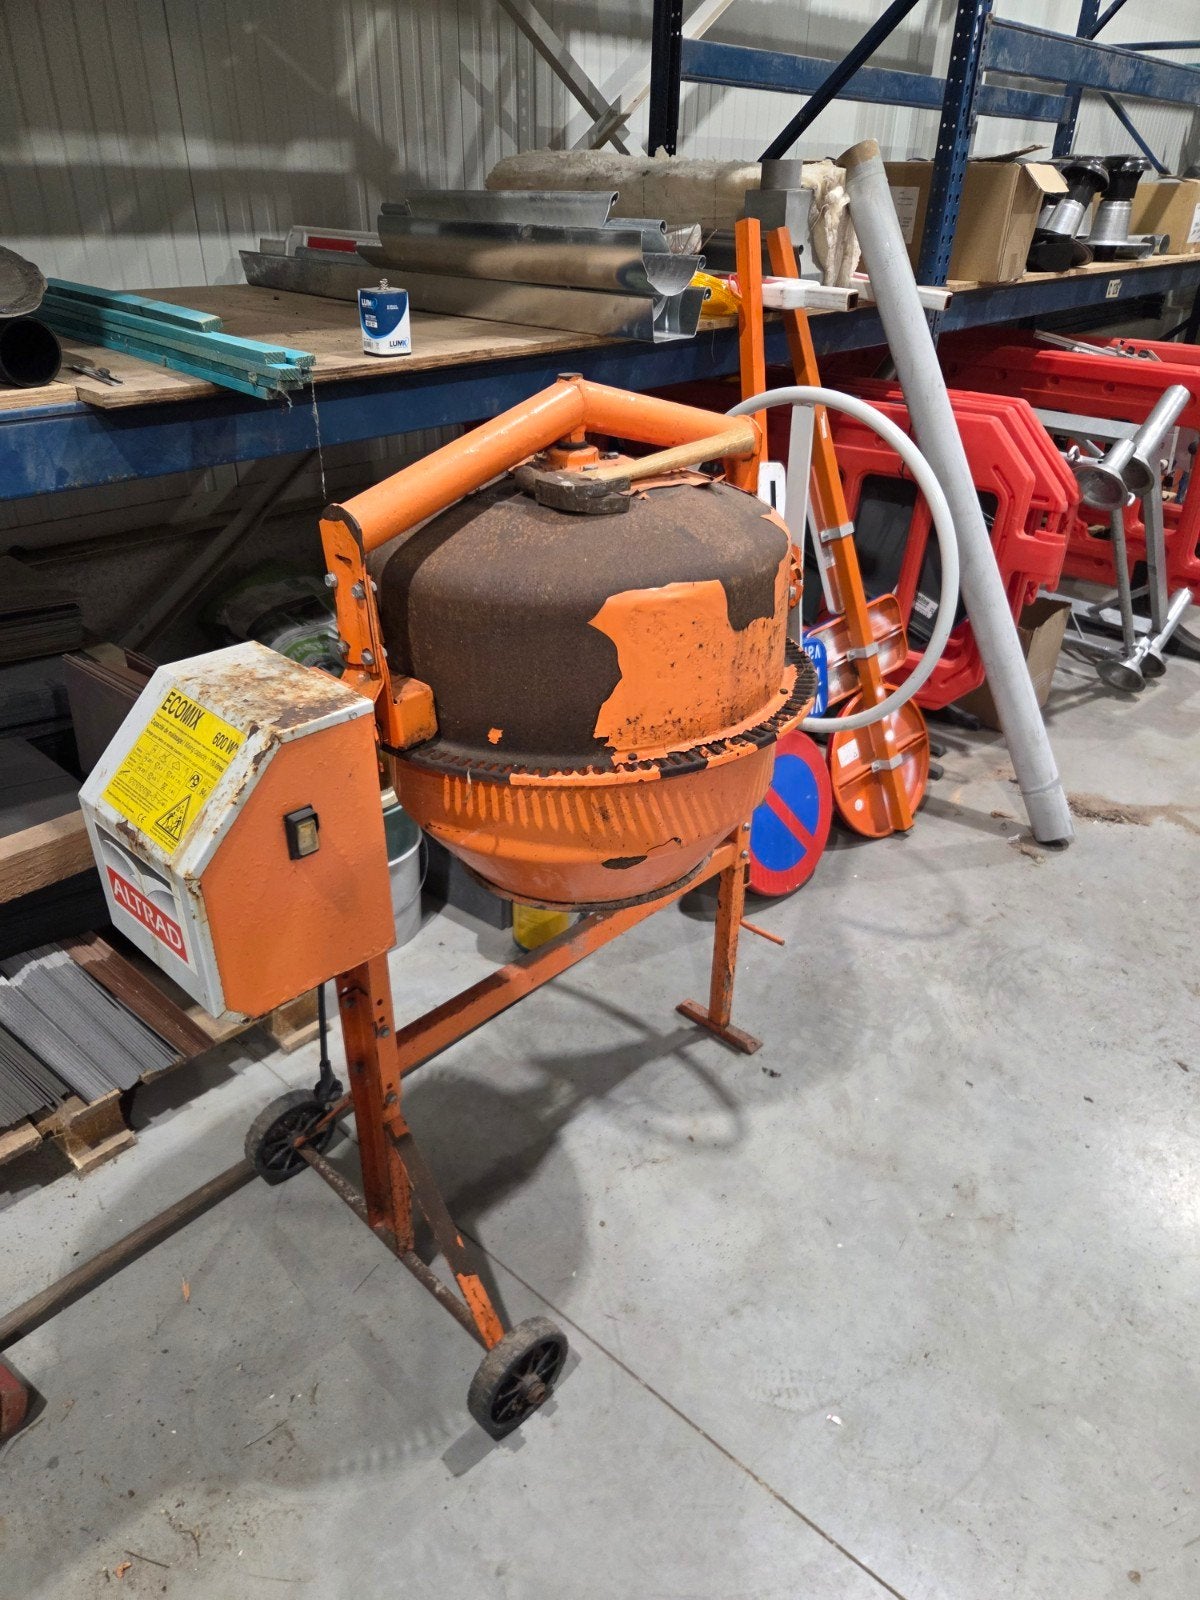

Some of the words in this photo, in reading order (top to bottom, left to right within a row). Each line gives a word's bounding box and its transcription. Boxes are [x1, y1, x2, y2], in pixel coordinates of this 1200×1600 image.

[162, 692, 205, 730] ECOMIX
[212, 732, 229, 750] 600
[114, 878, 182, 950] ALTRAD
